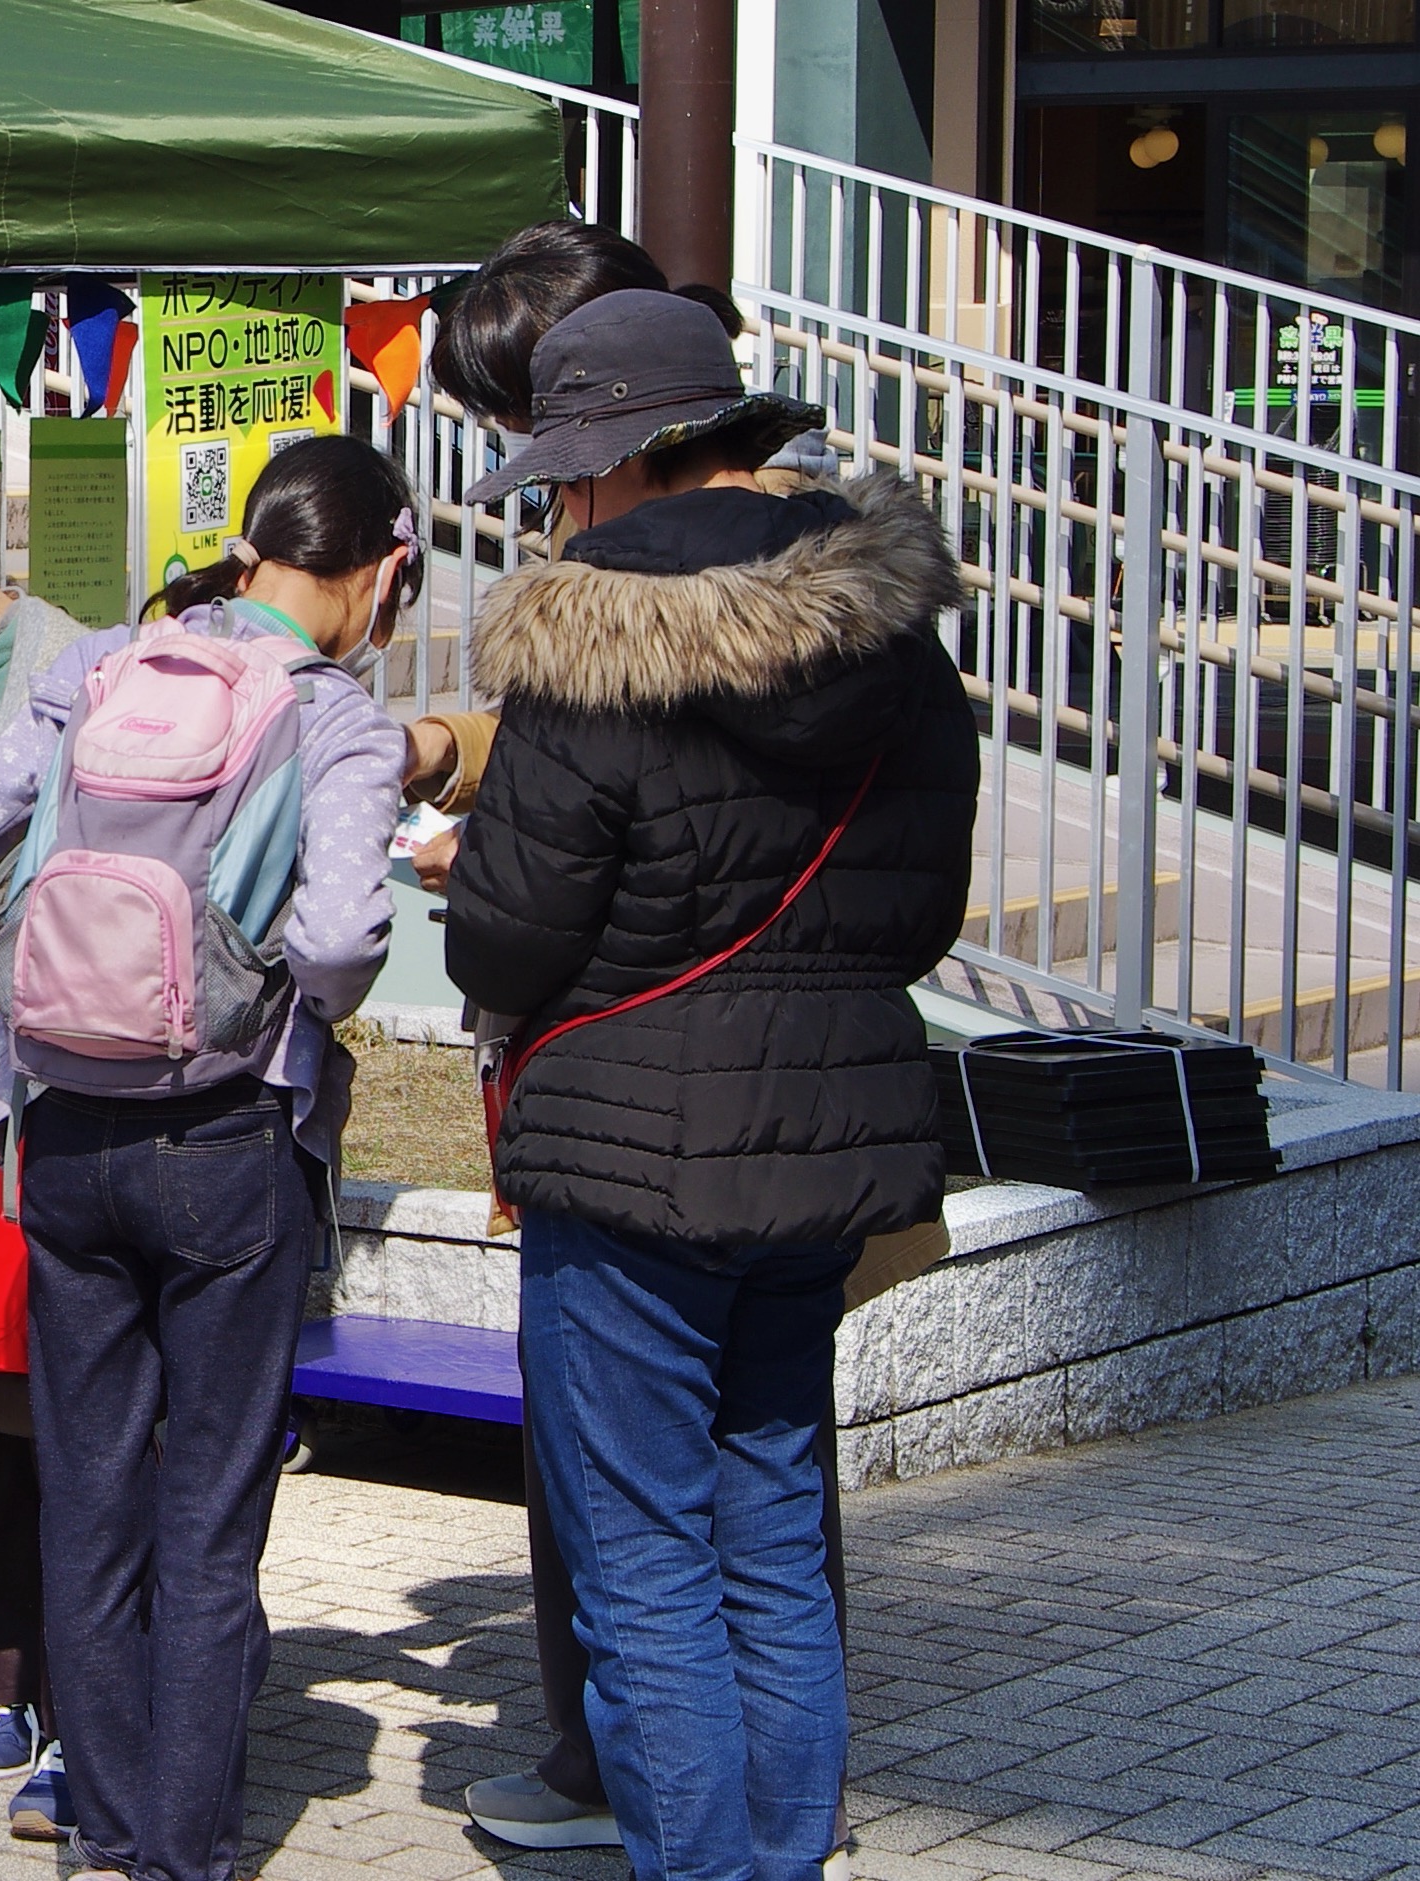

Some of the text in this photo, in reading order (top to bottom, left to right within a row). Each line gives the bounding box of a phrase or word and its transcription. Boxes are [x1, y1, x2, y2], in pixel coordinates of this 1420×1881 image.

[163, 317, 325, 373] NPO・地域の
[193, 533, 218, 549] LINE
